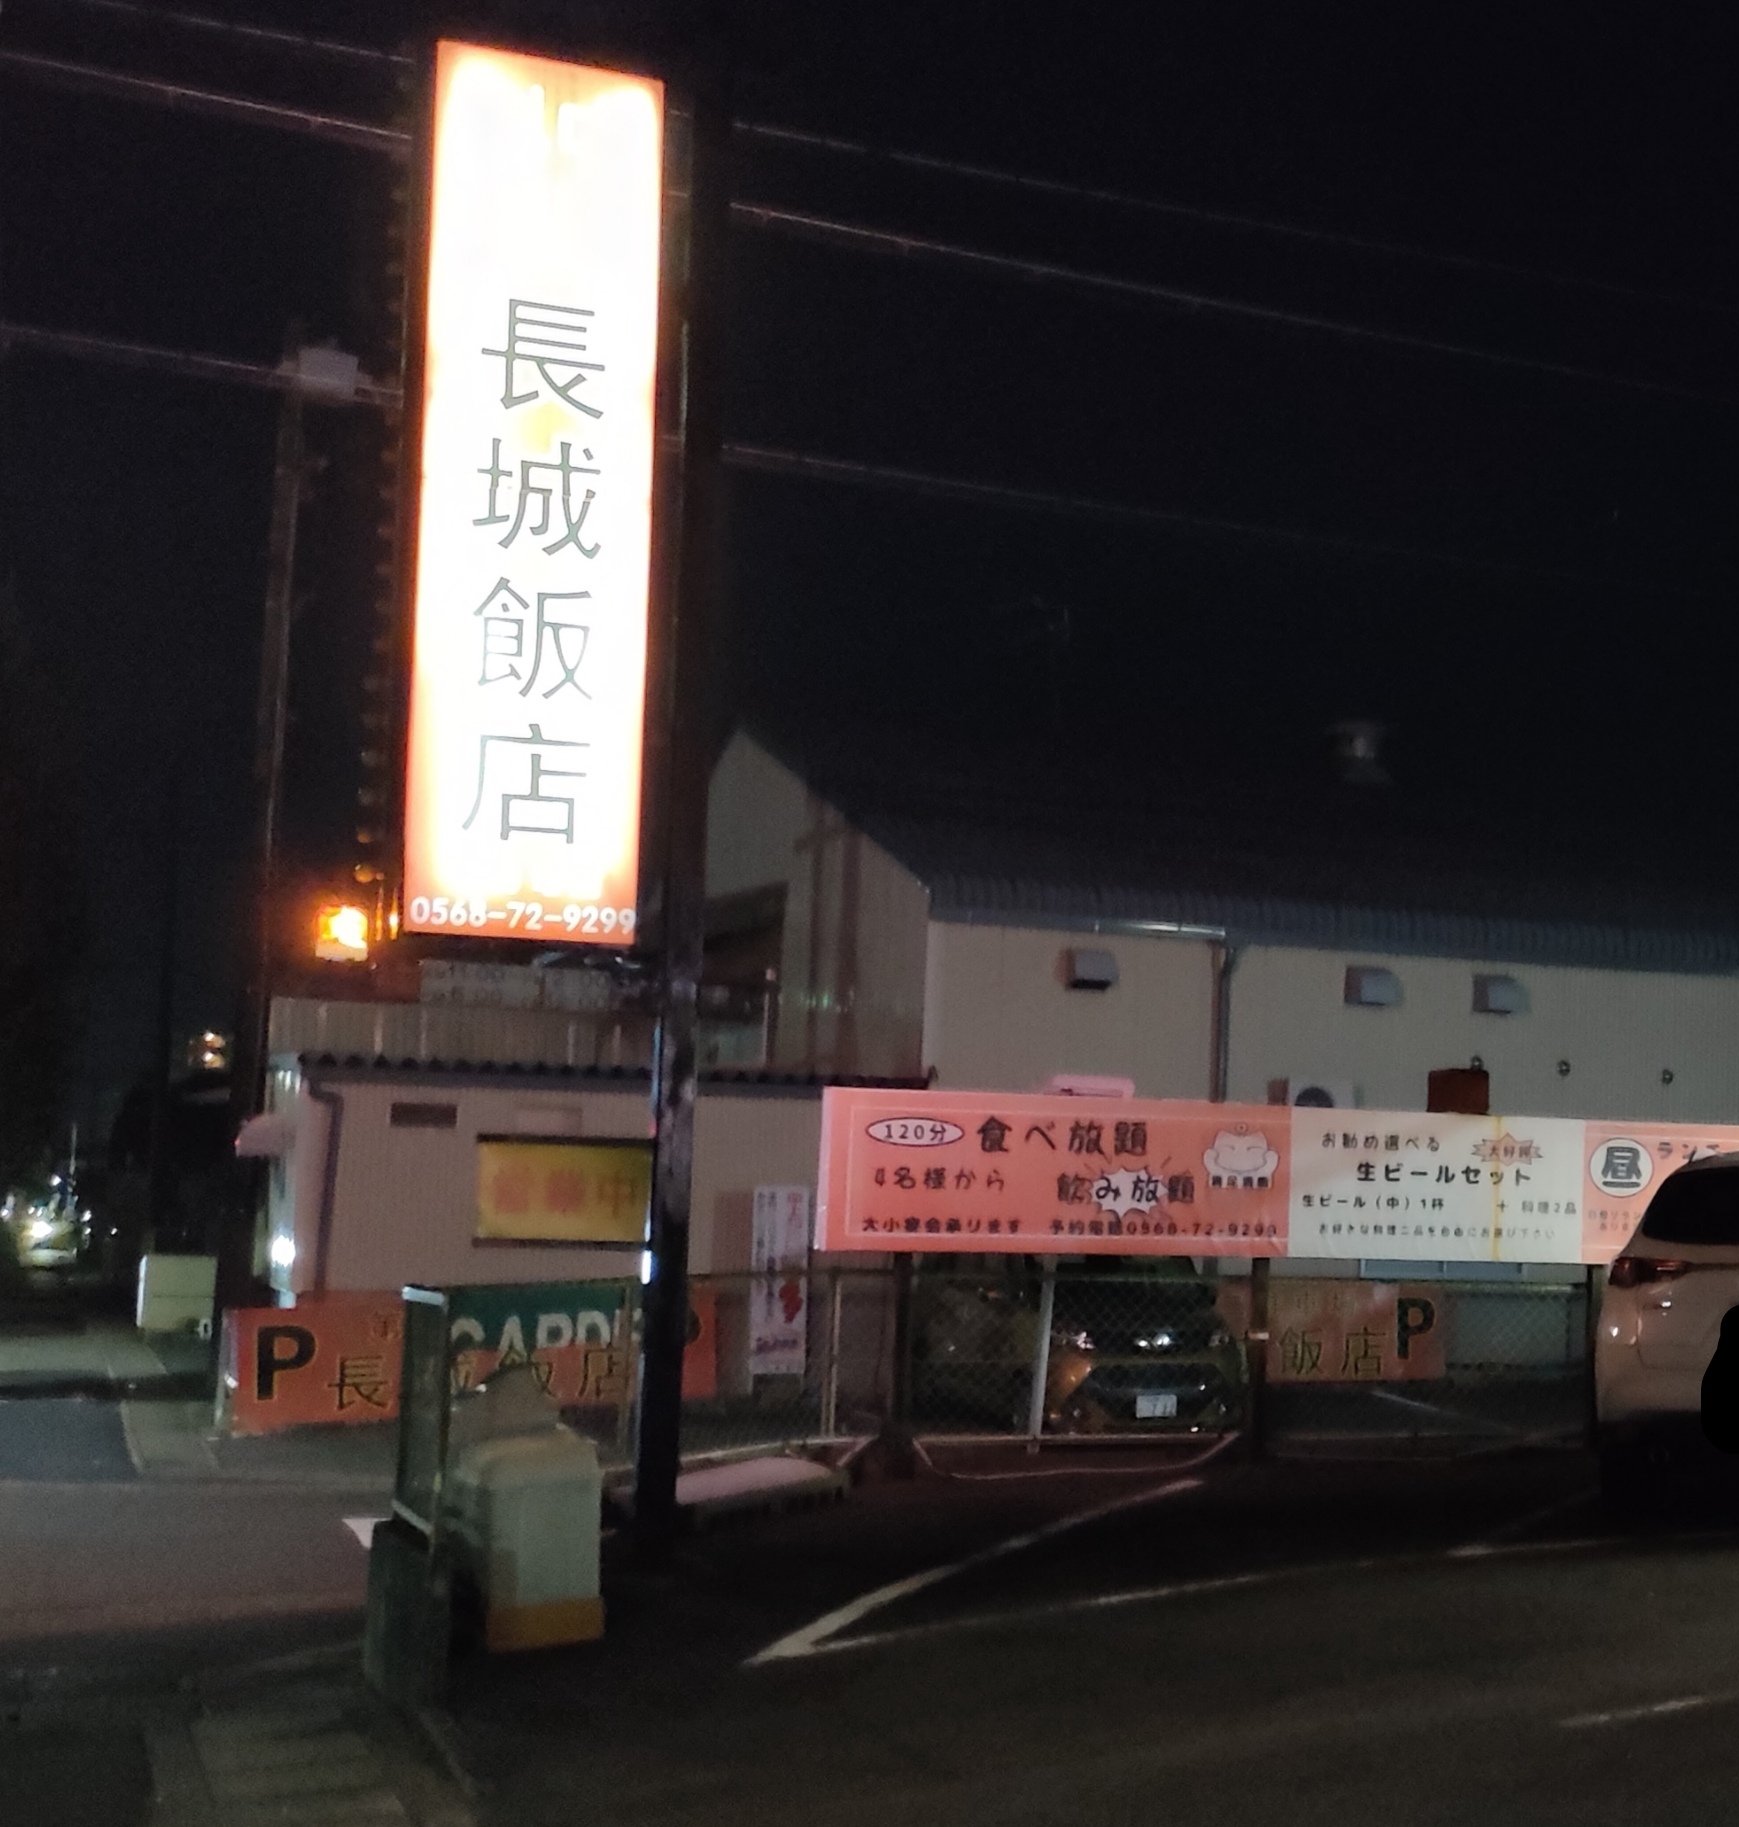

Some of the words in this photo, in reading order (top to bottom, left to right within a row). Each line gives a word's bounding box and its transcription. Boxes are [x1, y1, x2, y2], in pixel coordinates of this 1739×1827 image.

[462, 299, 606, 846] 長城飯店
[409, 900, 638, 936] 0568-72-9299
[883, 1122, 949, 1141] 120分
[976, 1115, 1149, 1157] 食べ放題
[1321, 1132, 1441, 1153] お勧め選べる
[874, 1166, 1006, 1191] 4名様から
[1356, 1161, 1532, 1187] 生ビールセット
[1601, 1145, 1643, 1189] 昼
[1056, 1171, 1195, 1206] 飲み放題
[1397, 1296, 1436, 1360] P
[256, 1324, 317, 1403] P
